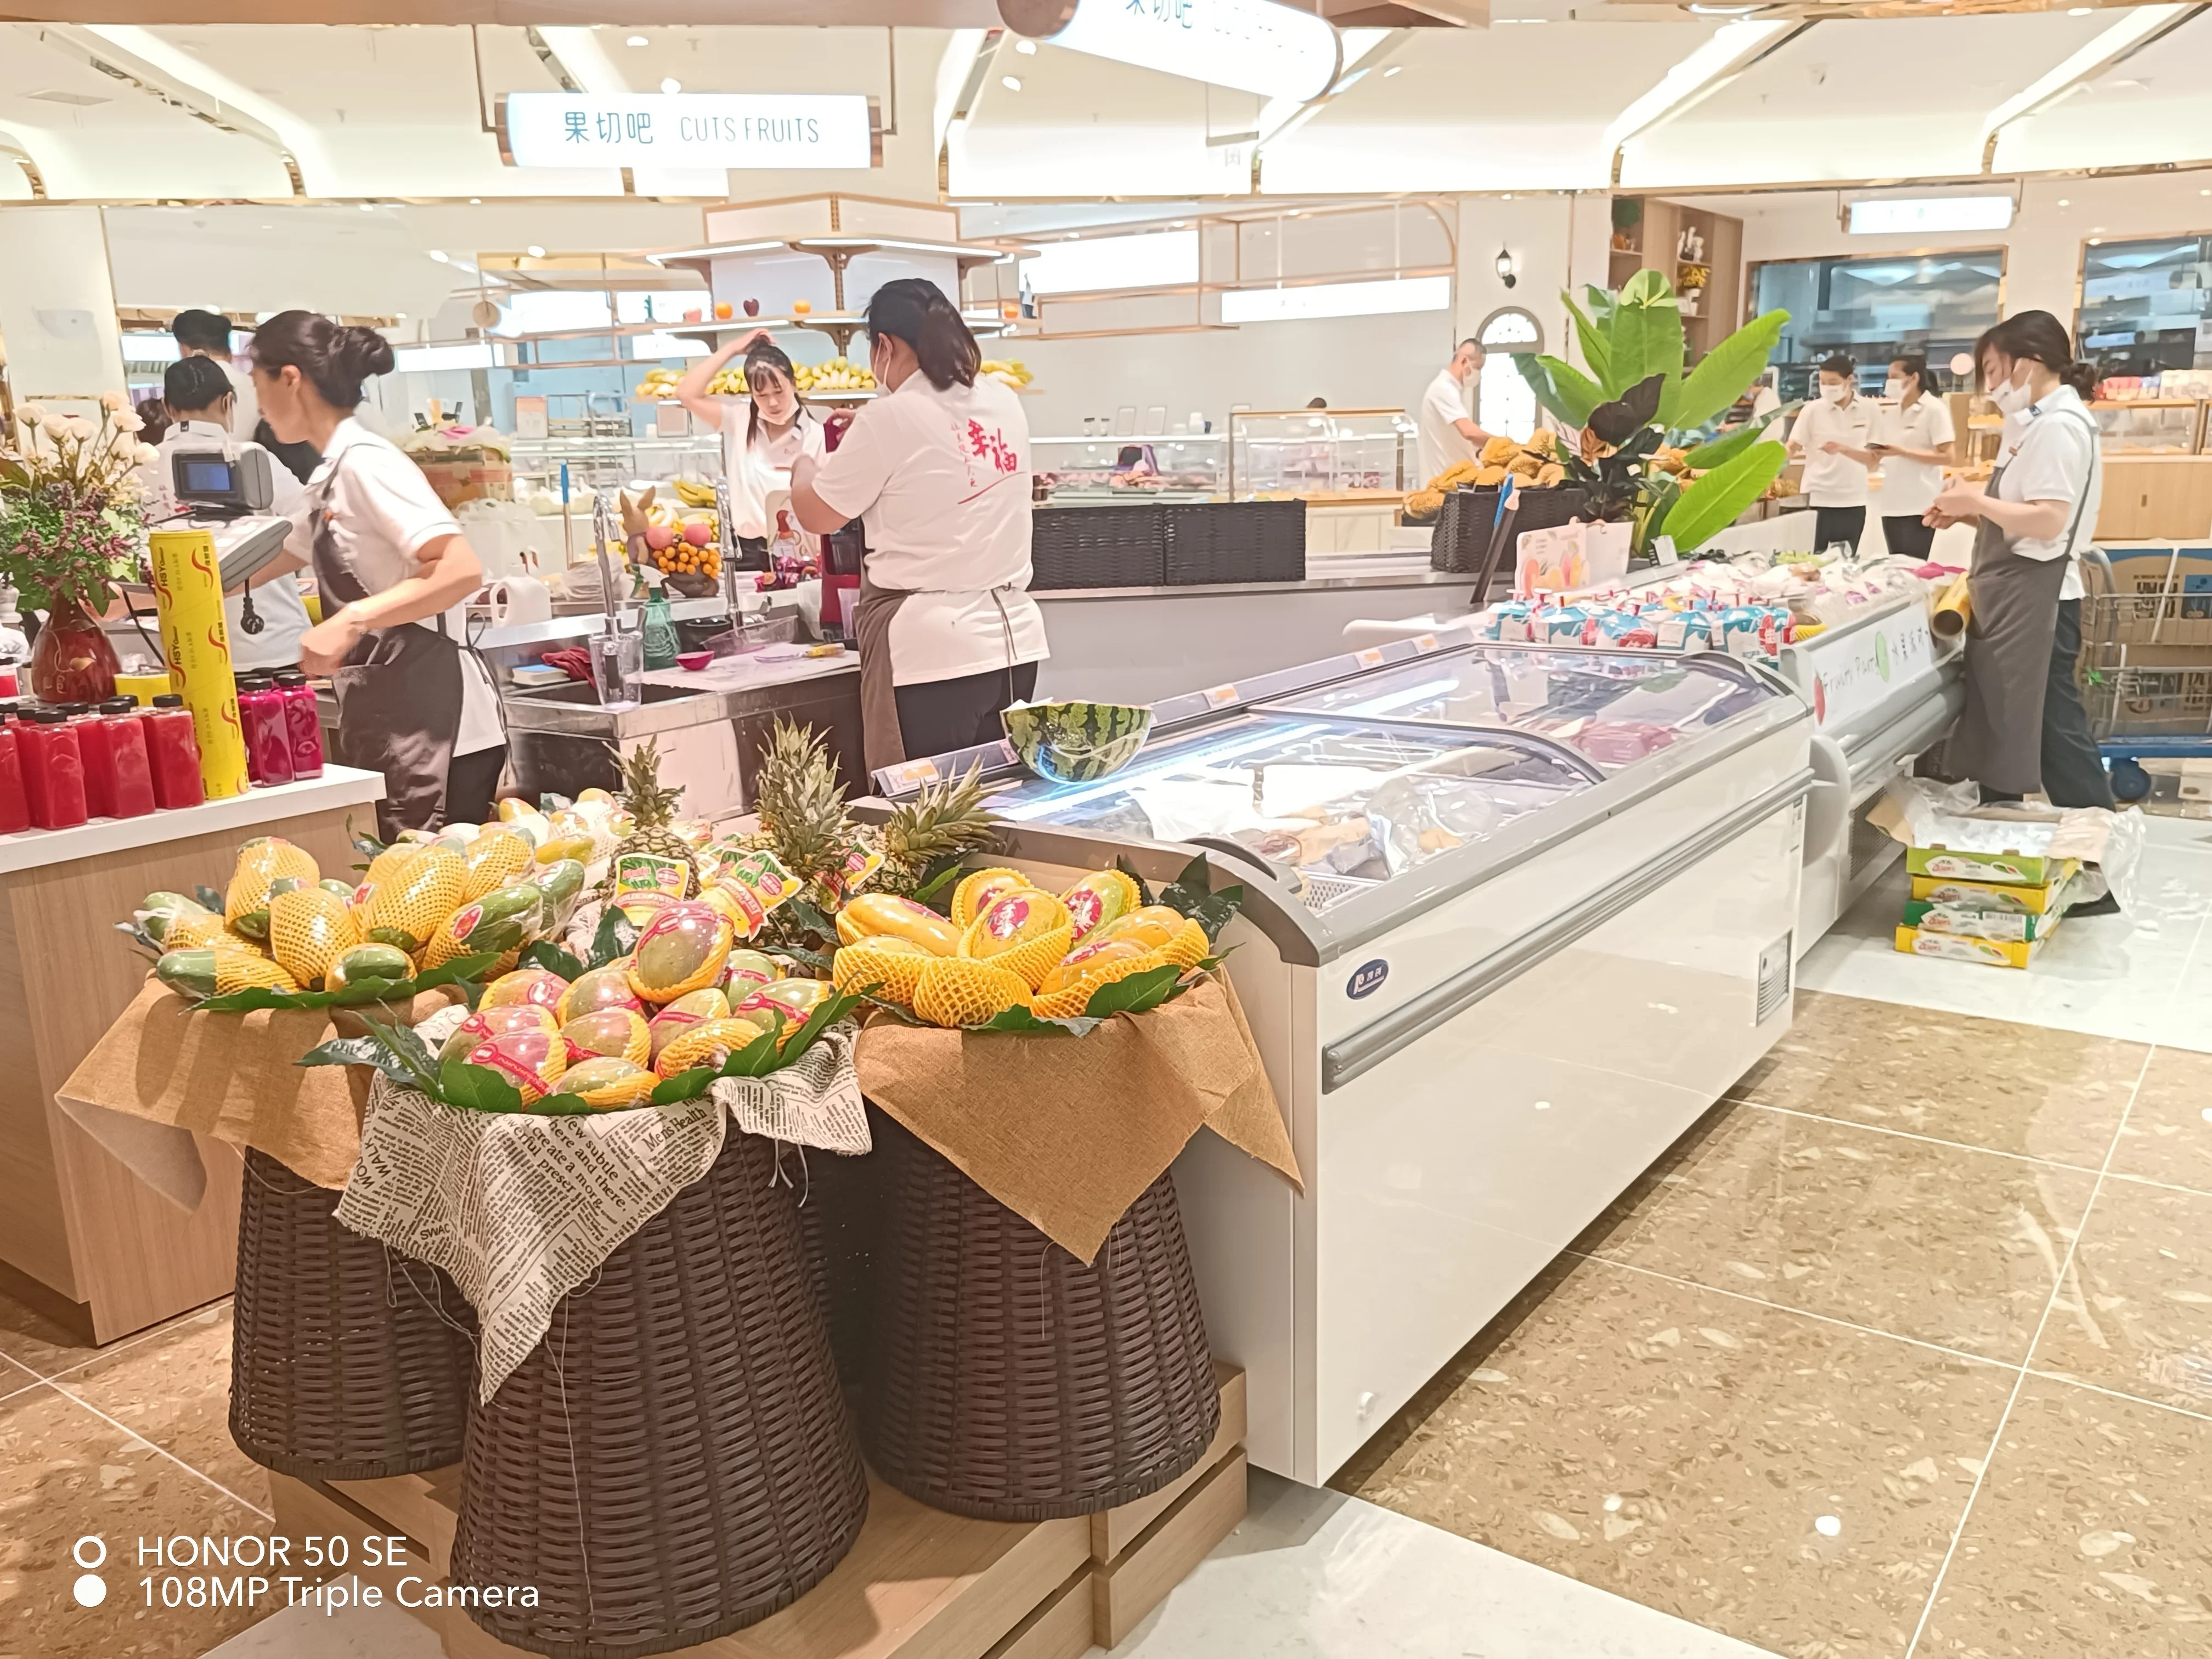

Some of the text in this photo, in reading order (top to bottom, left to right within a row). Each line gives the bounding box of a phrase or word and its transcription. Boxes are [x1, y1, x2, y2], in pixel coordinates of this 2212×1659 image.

[565, 111, 819, 144] 果切吧 CUTS FRUITS
[669, 1107, 708, 1132] Health
[364, 1137, 392, 1178] WALK
[532, 1127, 567, 1165] create
[565, 1161, 576, 1173] a
[564, 1116, 619, 1181] few subtle
[537, 1159, 577, 1193] preser
[575, 1148, 598, 1175] and
[595, 1175, 627, 1212] there.
